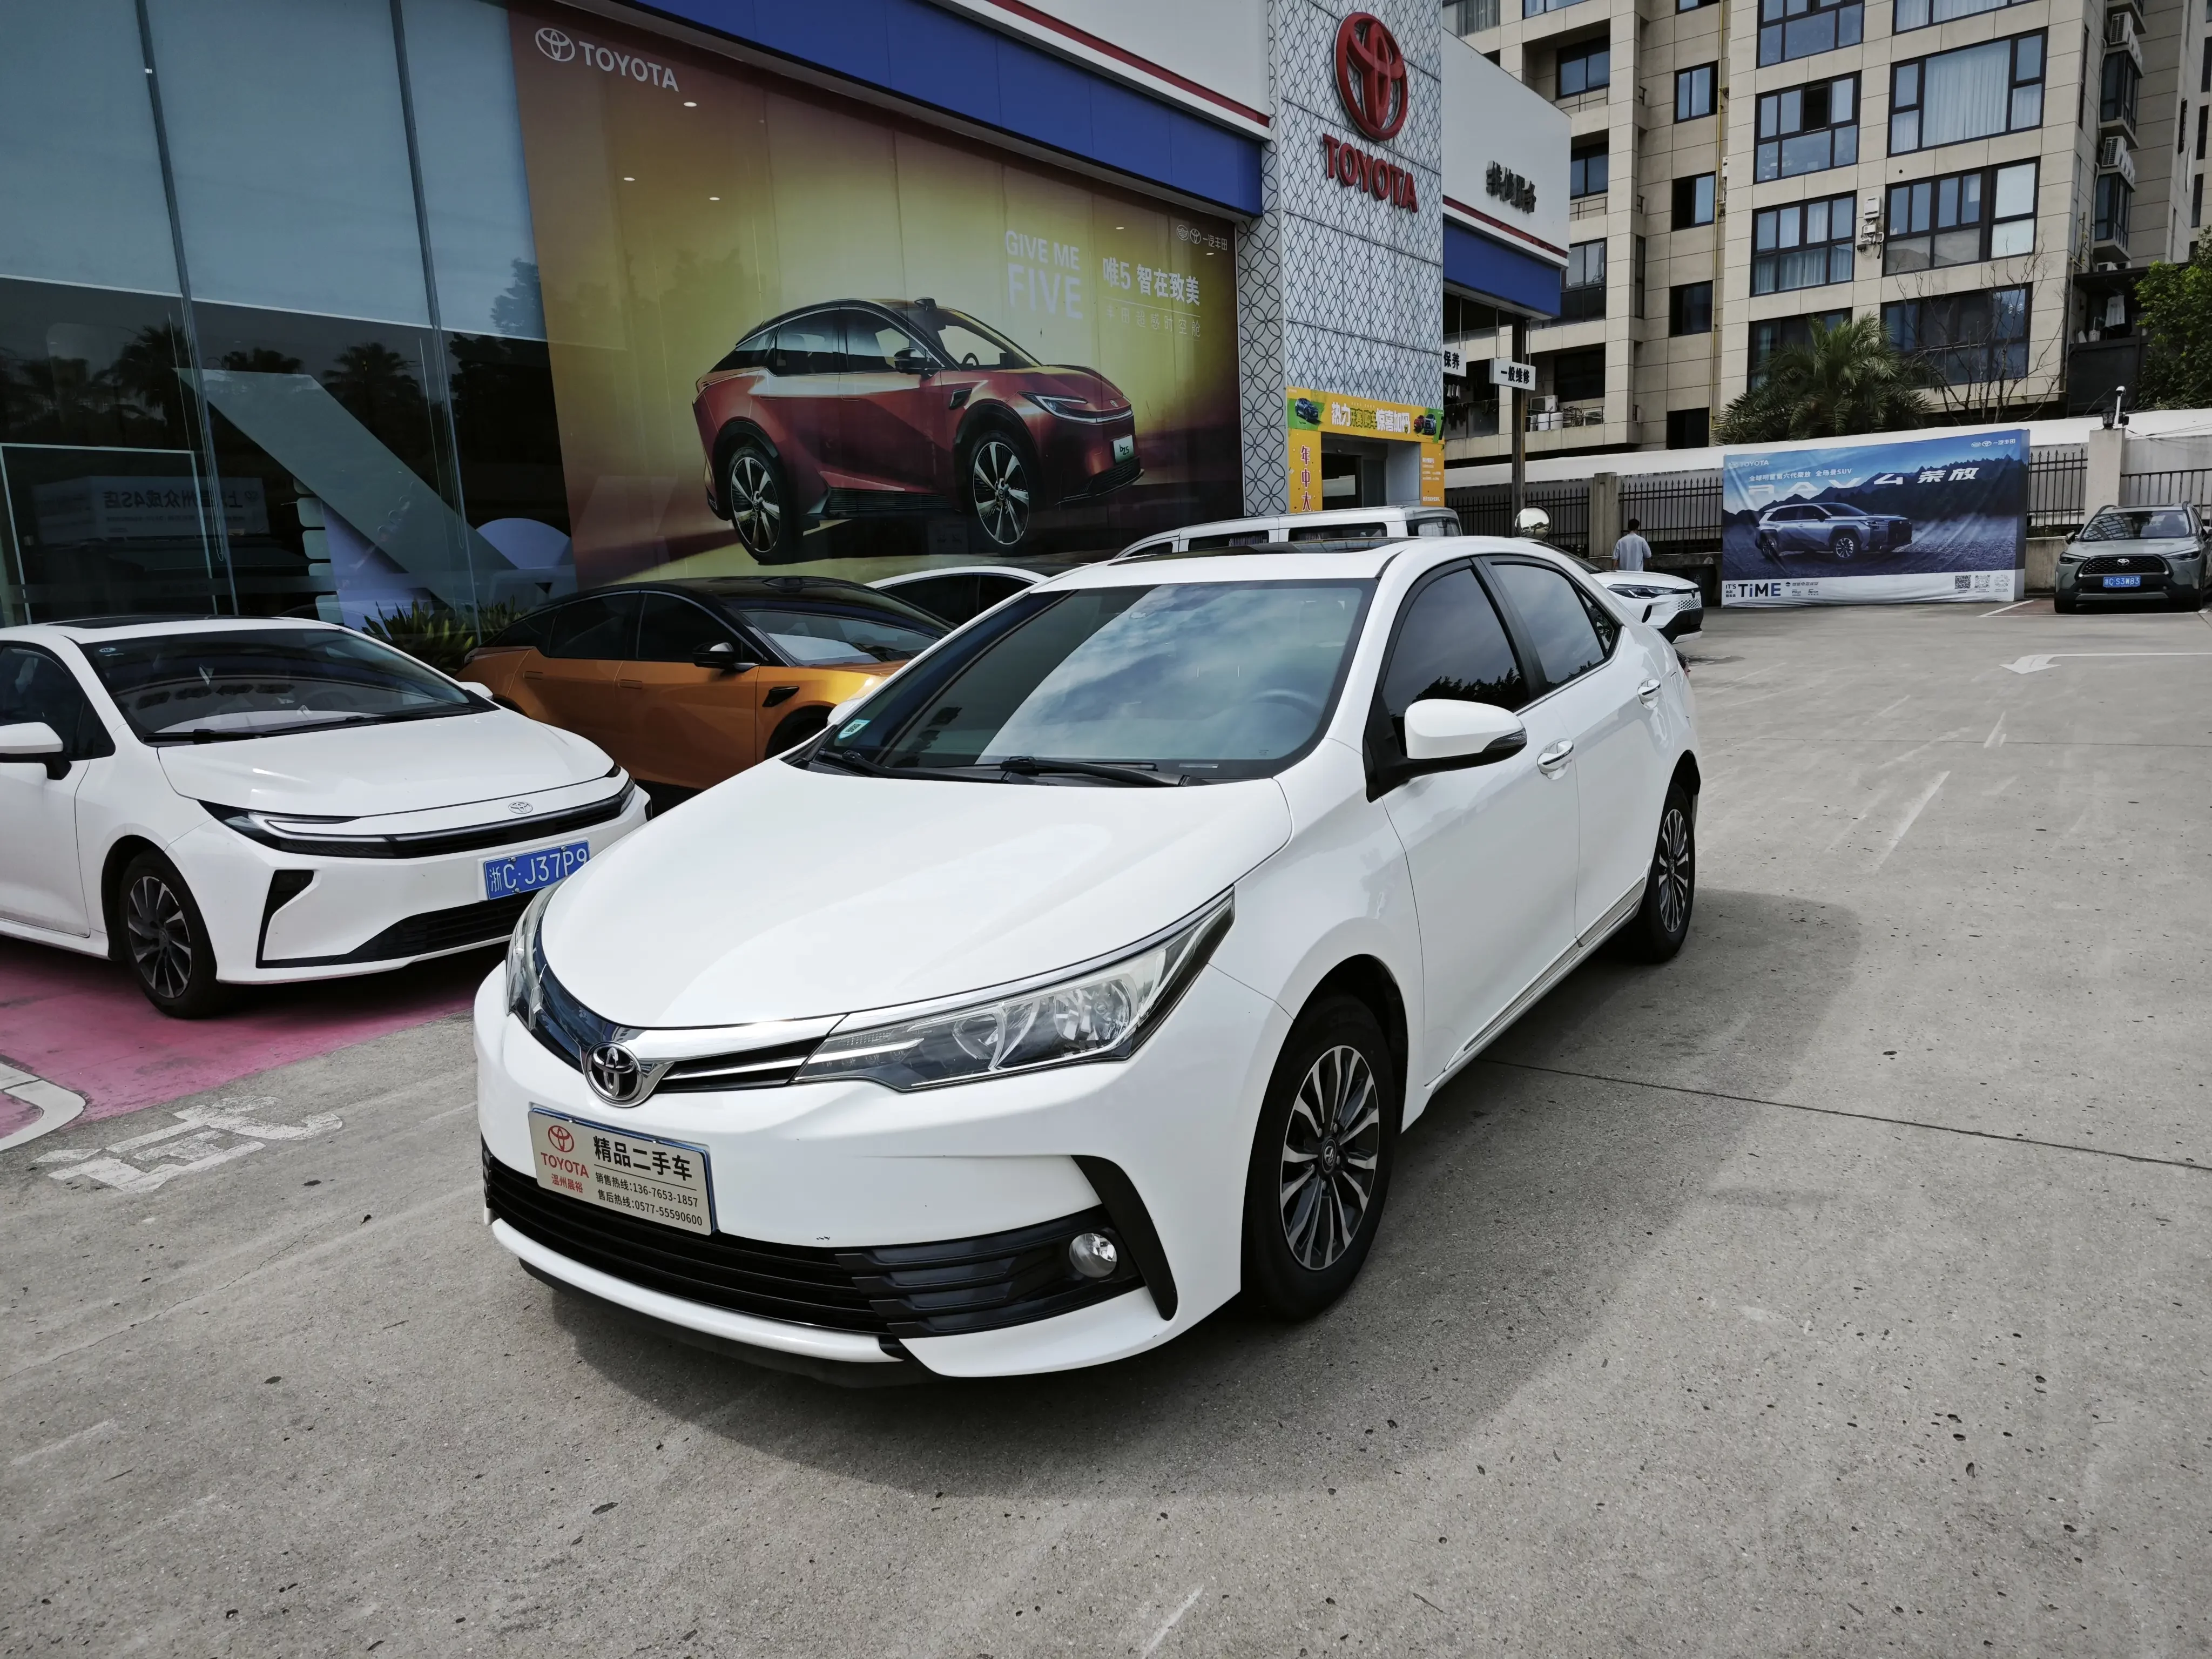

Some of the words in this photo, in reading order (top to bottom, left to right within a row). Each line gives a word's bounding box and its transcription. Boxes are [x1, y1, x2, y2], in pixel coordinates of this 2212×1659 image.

[579, 41, 679, 92] TOYOTA
[1322, 133, 1418, 213] TOYOTA
[1005, 230, 1049, 264] GIVE
[1053, 241, 1080, 271] ME
[1202, 233, 1228, 251] 一汽丰田
[1007, 263, 1083, 320] FIVE
[1102, 257, 1131, 289] 唯5
[1136, 263, 1201, 306] 智在致美
[1443, 350, 1460, 370] 保养
[1500, 365, 1530, 384] 一般维修
[1992, 438, 2016, 446] 一汽丰田
[1737, 583, 1782, 597] TiME
[541, 1151, 590, 1178] TOYOTA
[594, 1135, 692, 1182] 精品二手车
[551, 1173, 583, 1193] 温州晨裕
